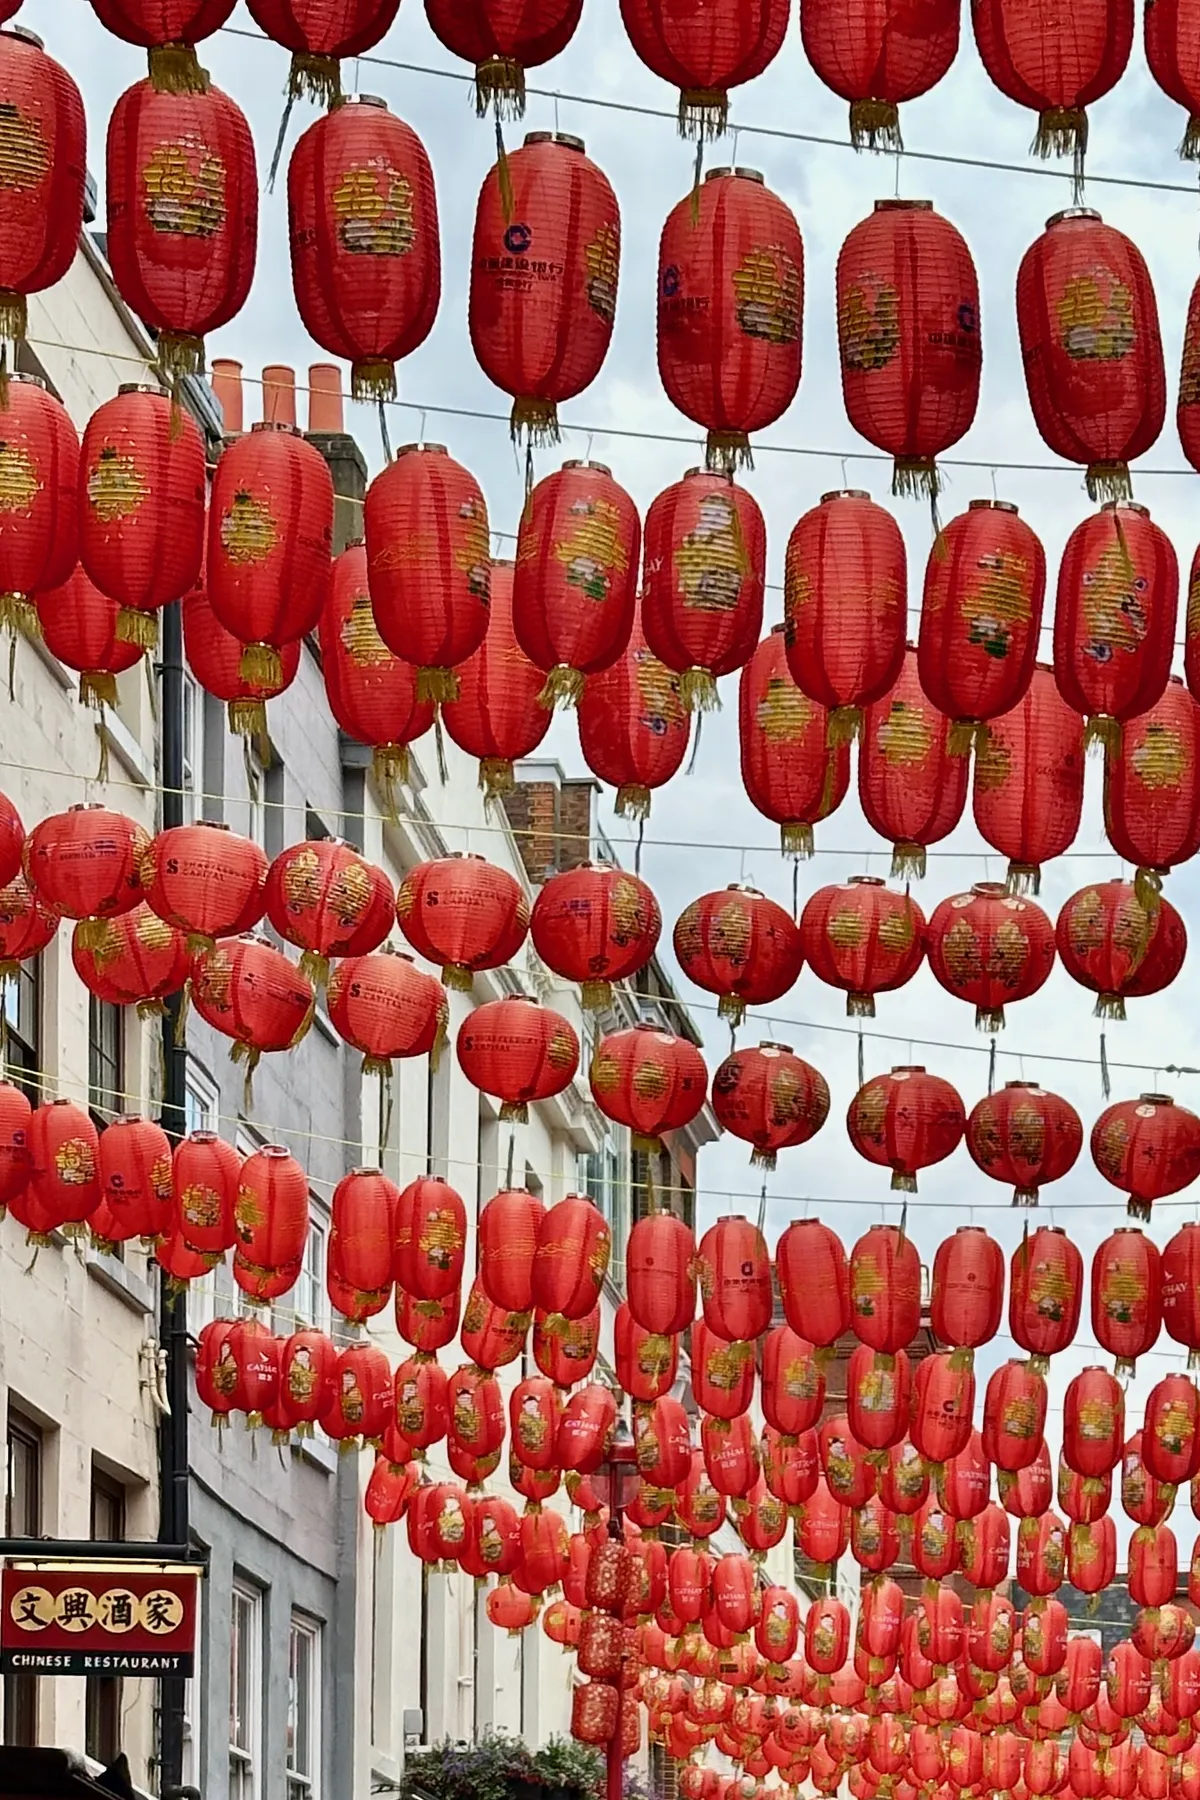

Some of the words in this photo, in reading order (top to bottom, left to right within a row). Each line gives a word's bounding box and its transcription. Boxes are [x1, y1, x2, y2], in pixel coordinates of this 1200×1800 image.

[15, 1592, 177, 1629] 文興酒家
[12, 1655, 71, 1667] CHINESE
[84, 1656, 180, 1669] RESTAURANT
